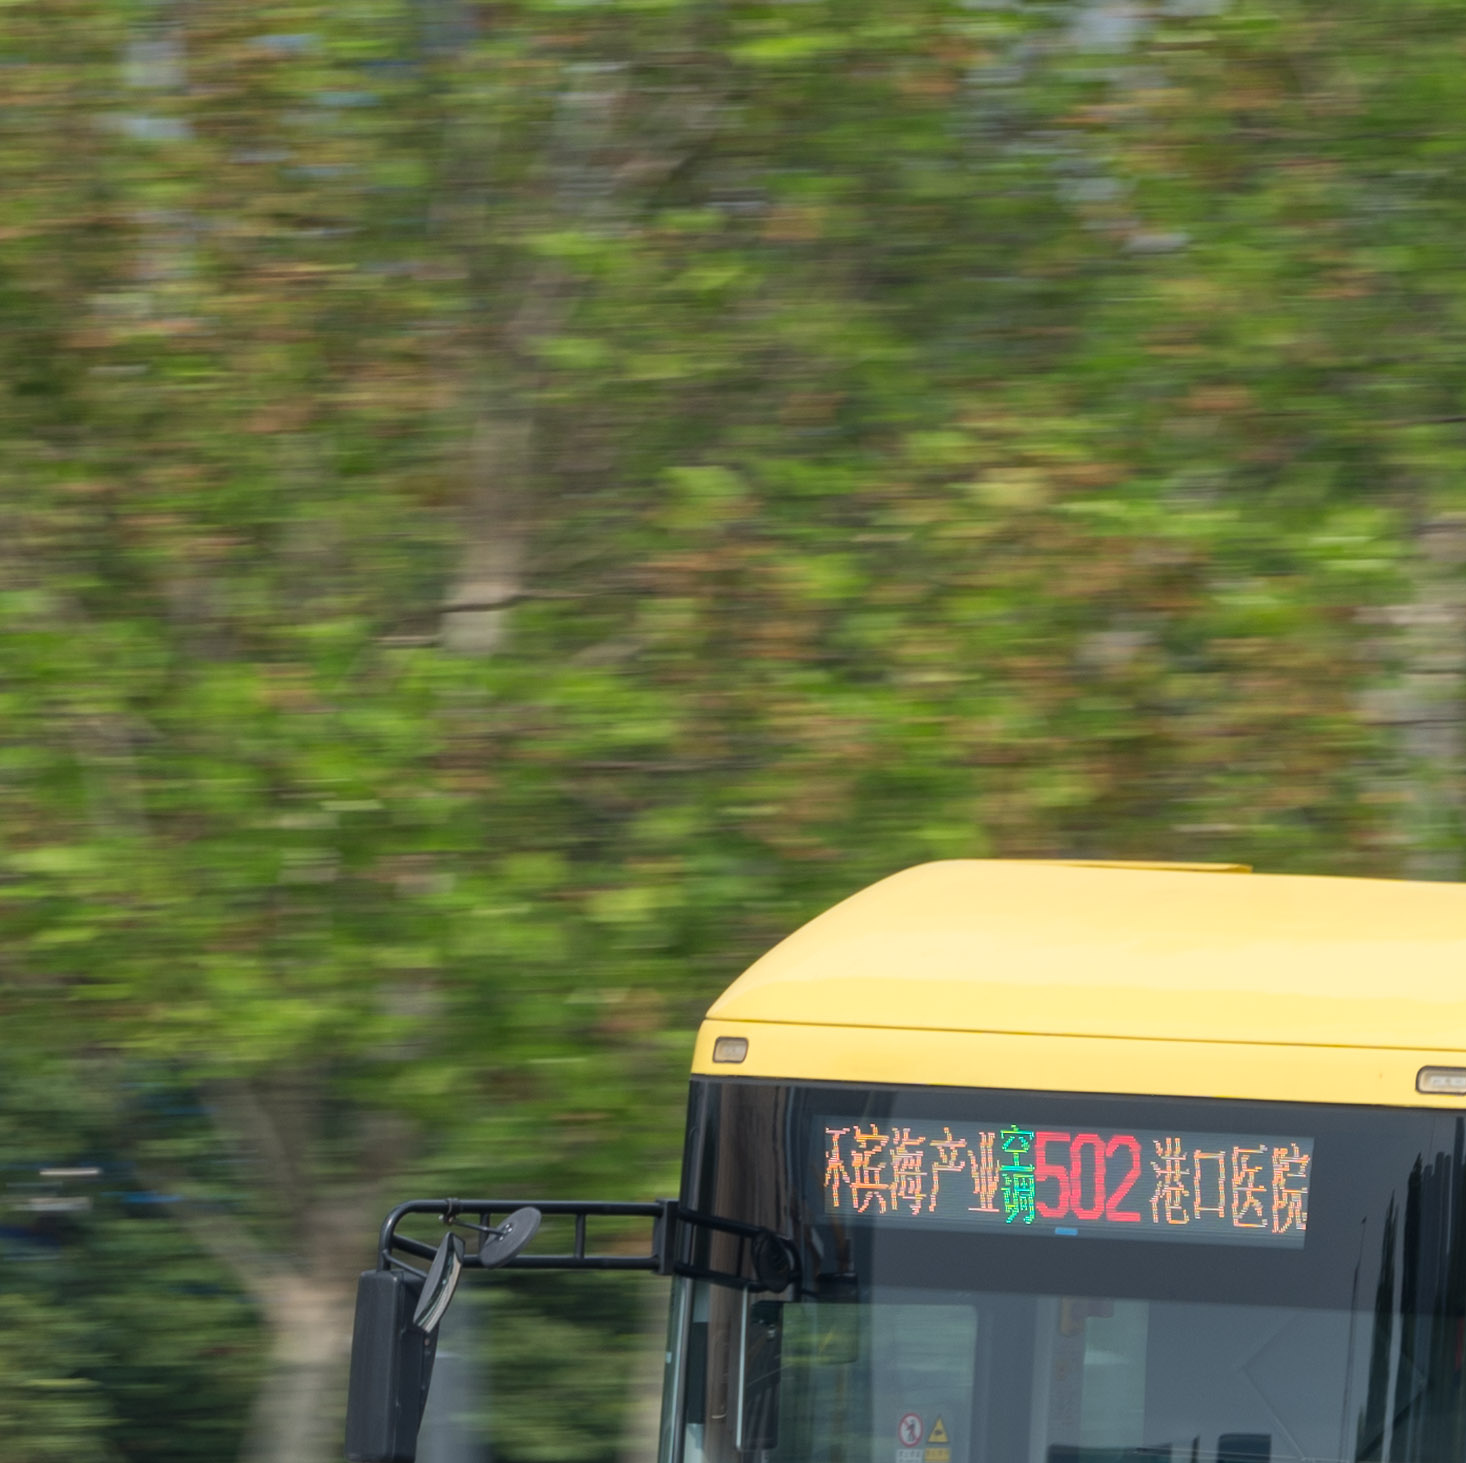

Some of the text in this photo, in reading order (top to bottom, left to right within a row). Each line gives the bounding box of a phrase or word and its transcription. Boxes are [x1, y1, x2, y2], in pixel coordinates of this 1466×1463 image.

[1001, 1124, 1035, 1224] 空调
[1036, 1130, 1142, 1221] 502
[1149, 1136, 1311, 1234] 港口医院
